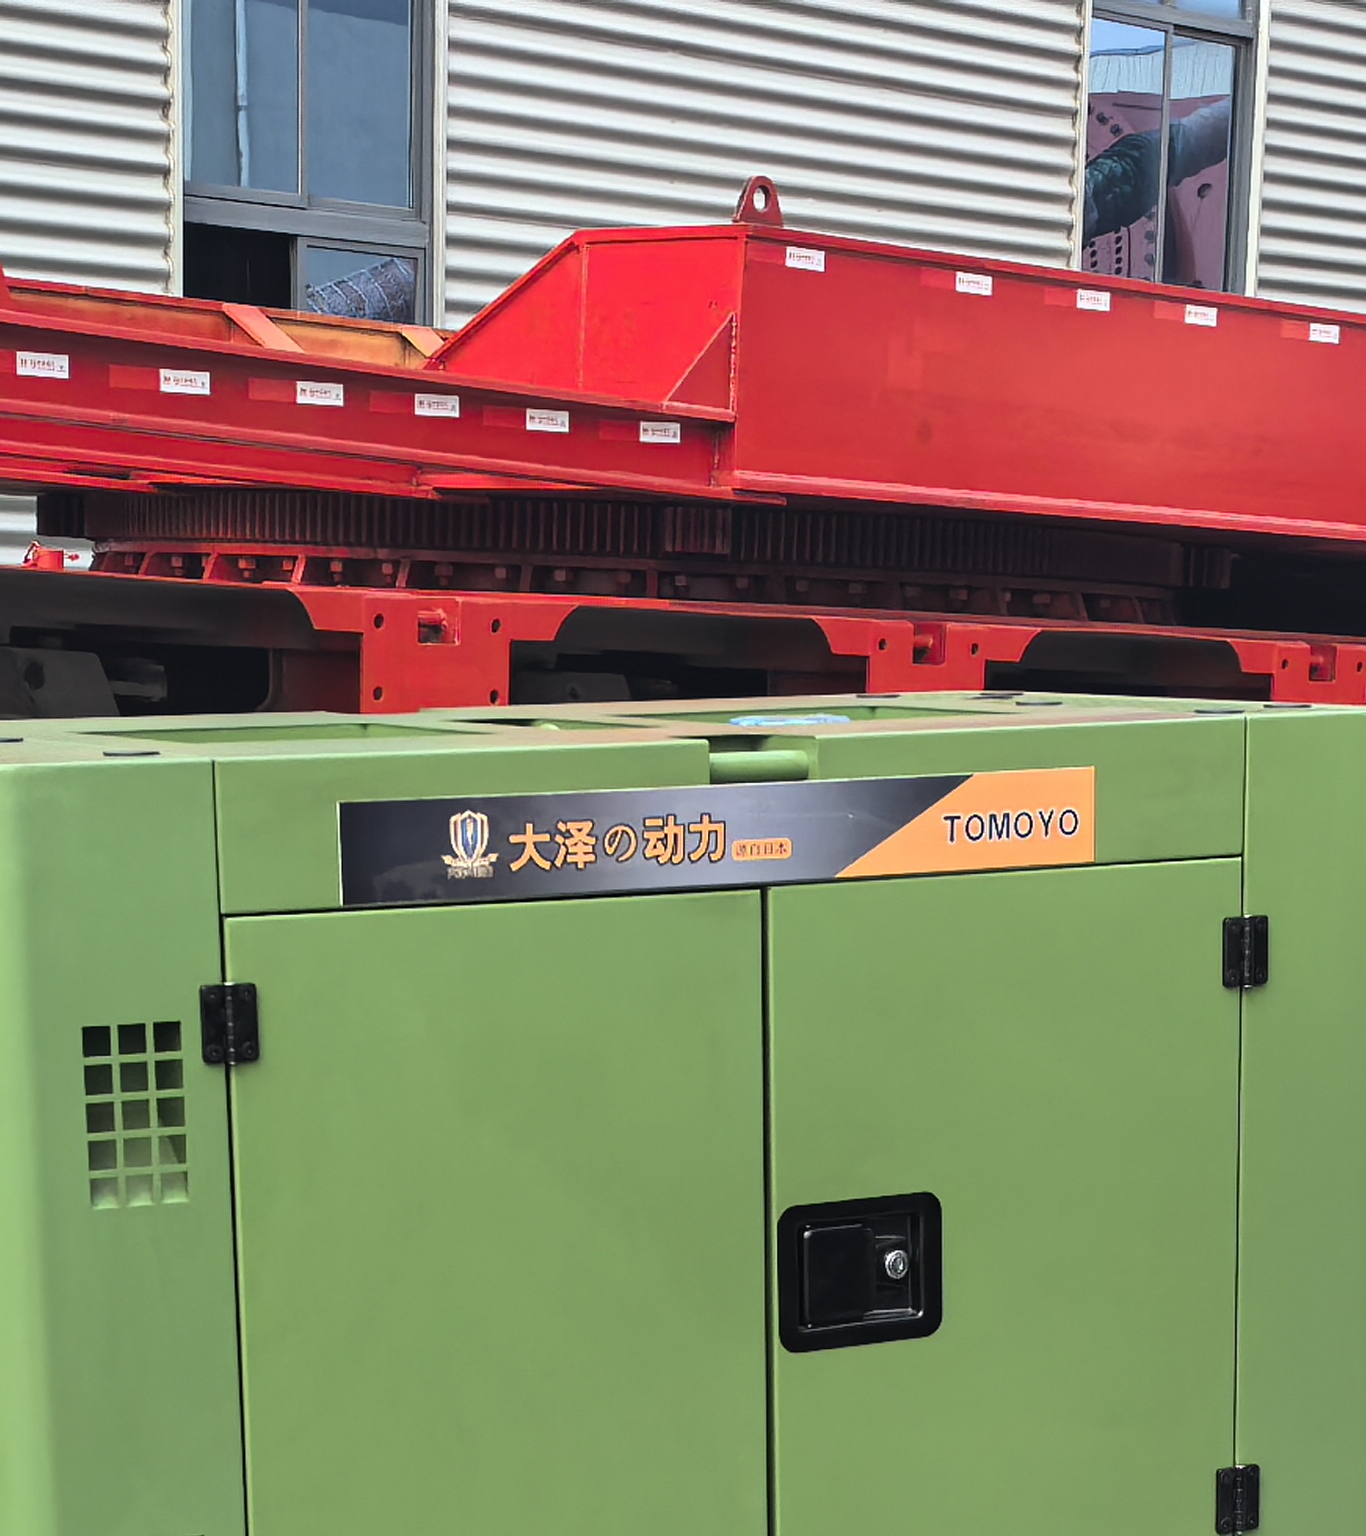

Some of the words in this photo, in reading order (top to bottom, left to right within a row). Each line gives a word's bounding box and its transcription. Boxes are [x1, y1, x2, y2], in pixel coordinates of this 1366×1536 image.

[508, 813, 727, 871] 大泽の动力
[943, 809, 1079, 843] TOMOYO
